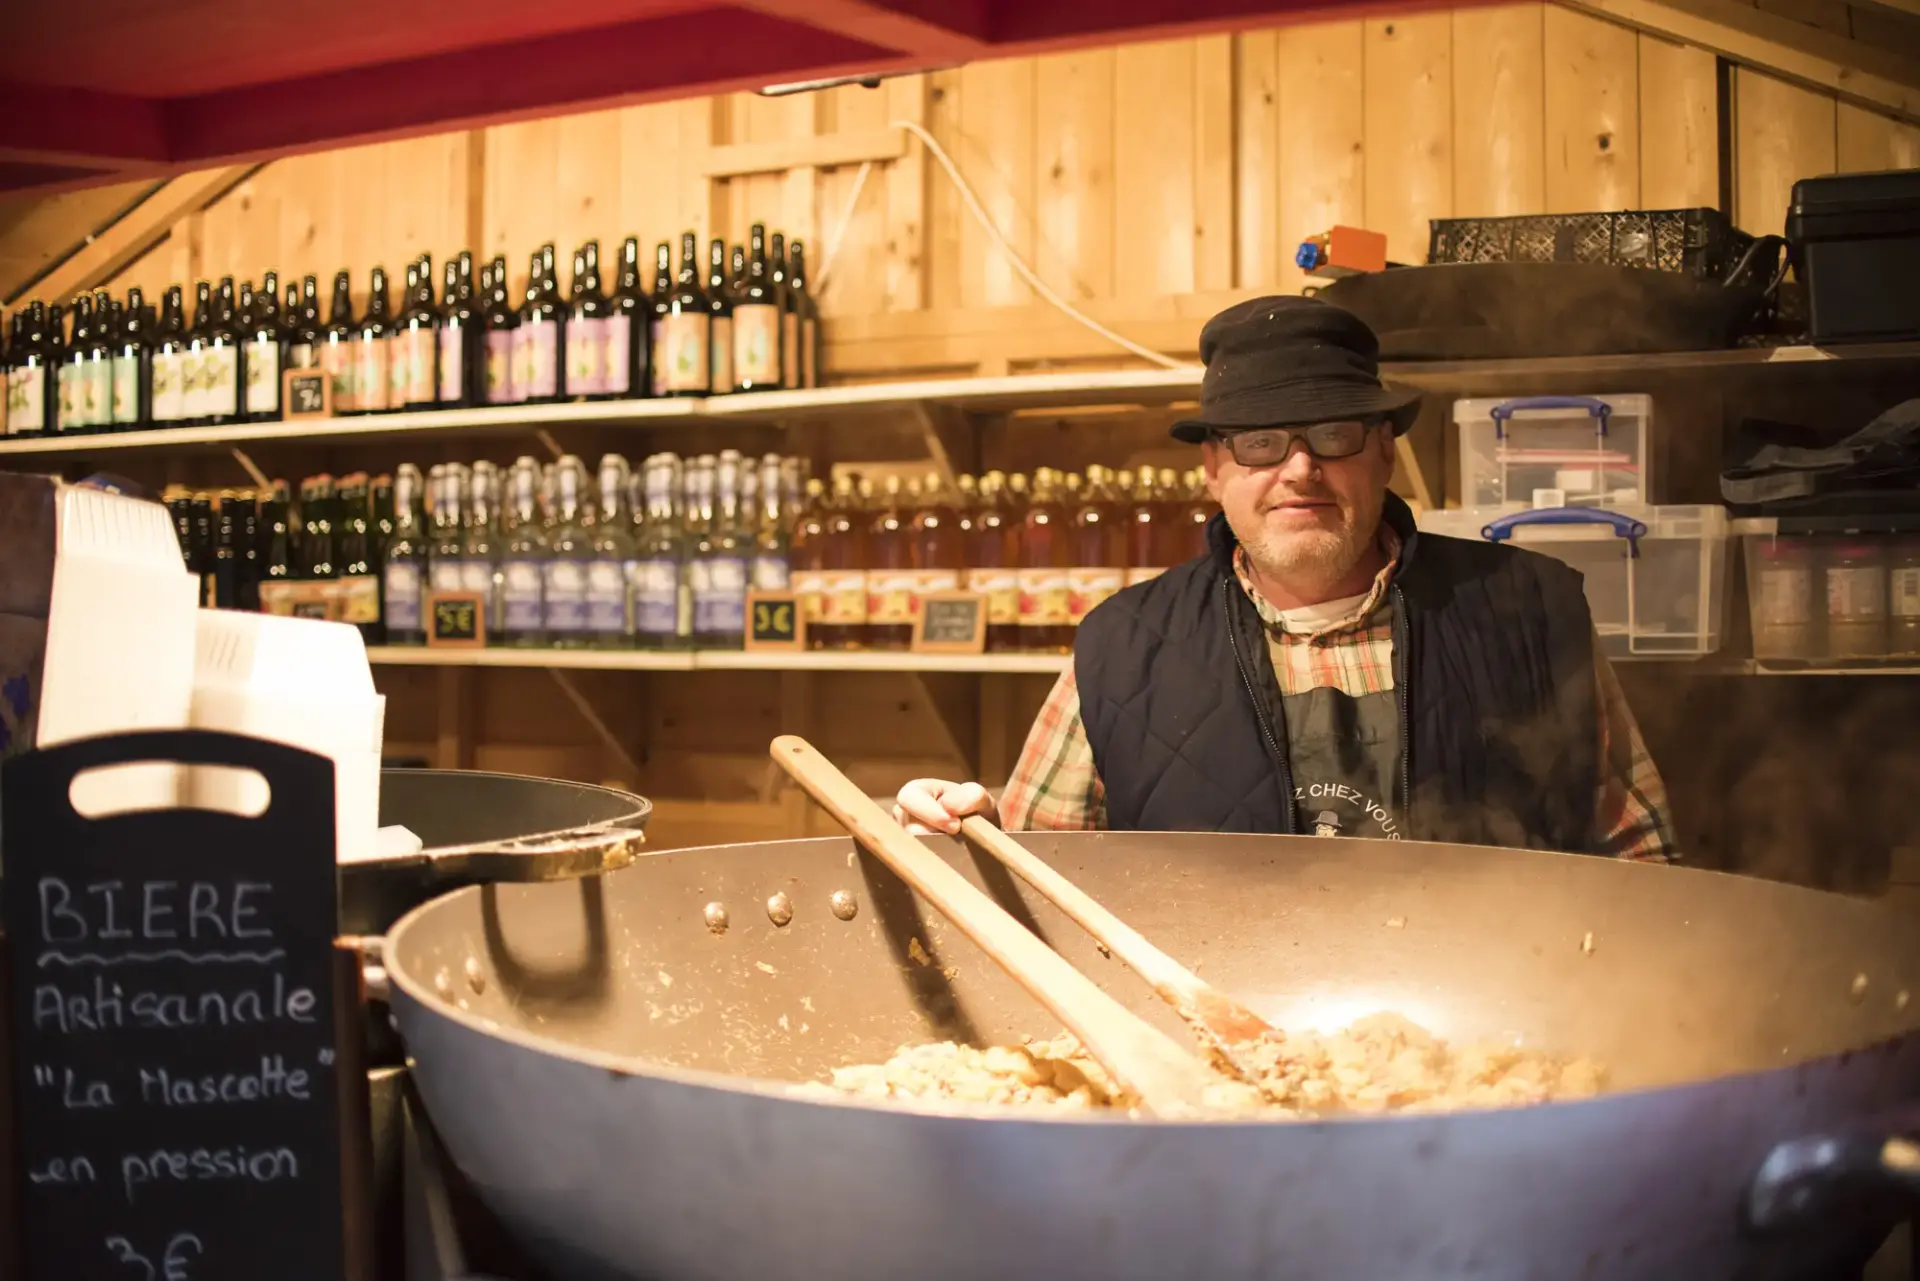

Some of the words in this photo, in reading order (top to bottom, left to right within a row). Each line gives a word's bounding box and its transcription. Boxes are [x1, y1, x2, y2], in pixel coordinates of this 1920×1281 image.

[1309, 783, 1363, 806] CHEZ
[1365, 799, 1401, 840] VOUS
[38, 877, 272, 942] BIERE
[123, 1146, 300, 1203] pression
